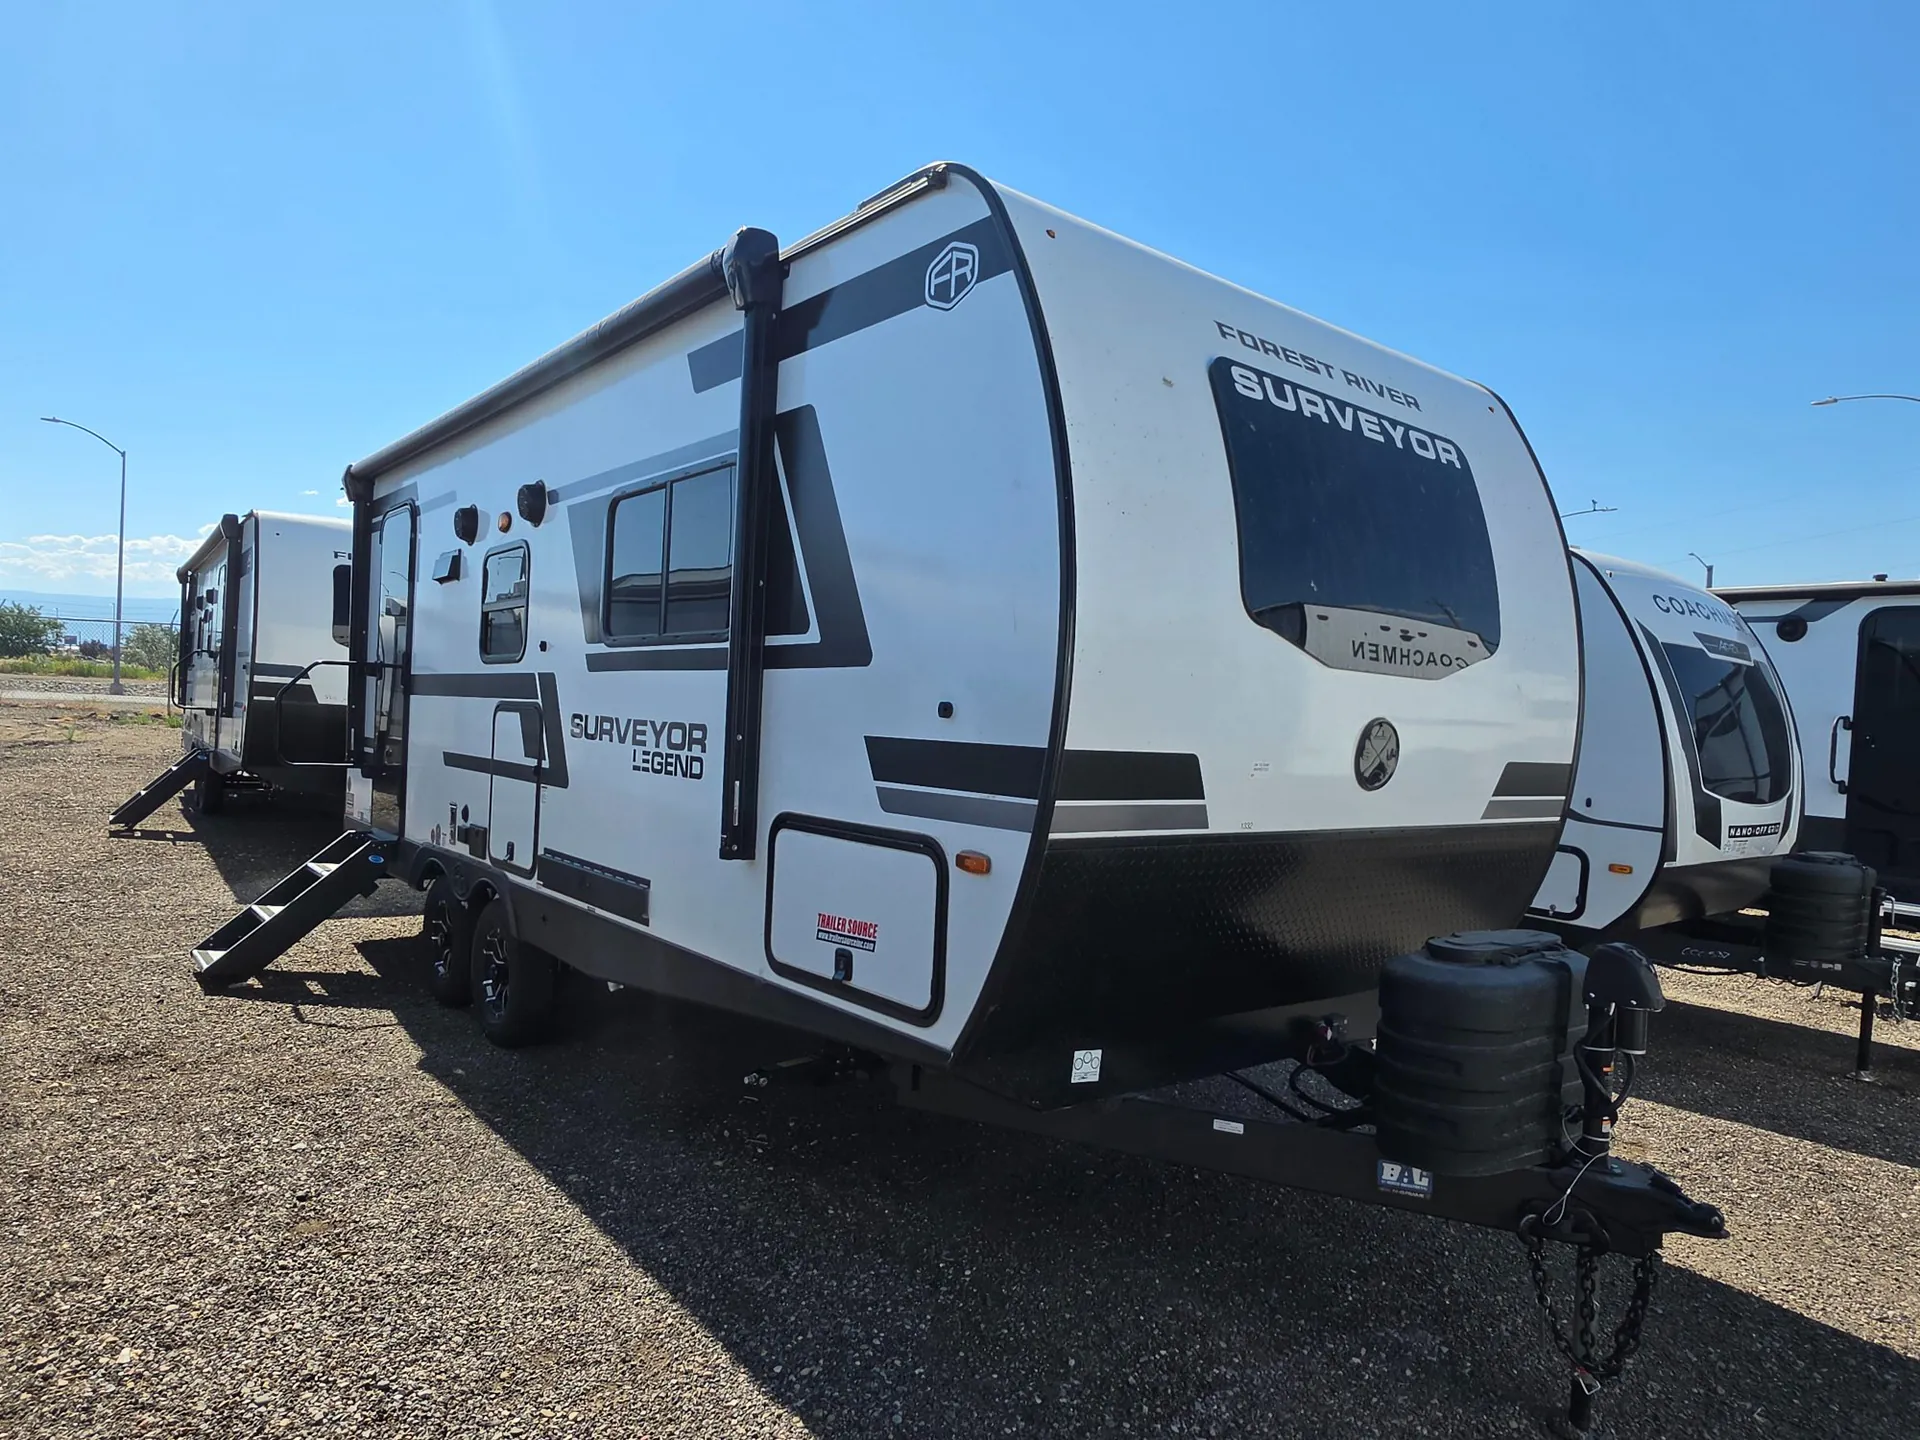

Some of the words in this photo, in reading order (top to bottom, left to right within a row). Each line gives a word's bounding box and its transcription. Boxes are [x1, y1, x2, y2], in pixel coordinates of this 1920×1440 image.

[1213, 320, 1334, 380] FOREST
[1340, 368, 1423, 412] RIVER
[1230, 365, 1461, 469] SURVEYOR
[570, 712, 708, 754] SURVEYOR
[632, 748, 704, 780] LEGEND
[817, 912, 847, 933] TRAILER
[847, 918, 878, 939] SOURCE
